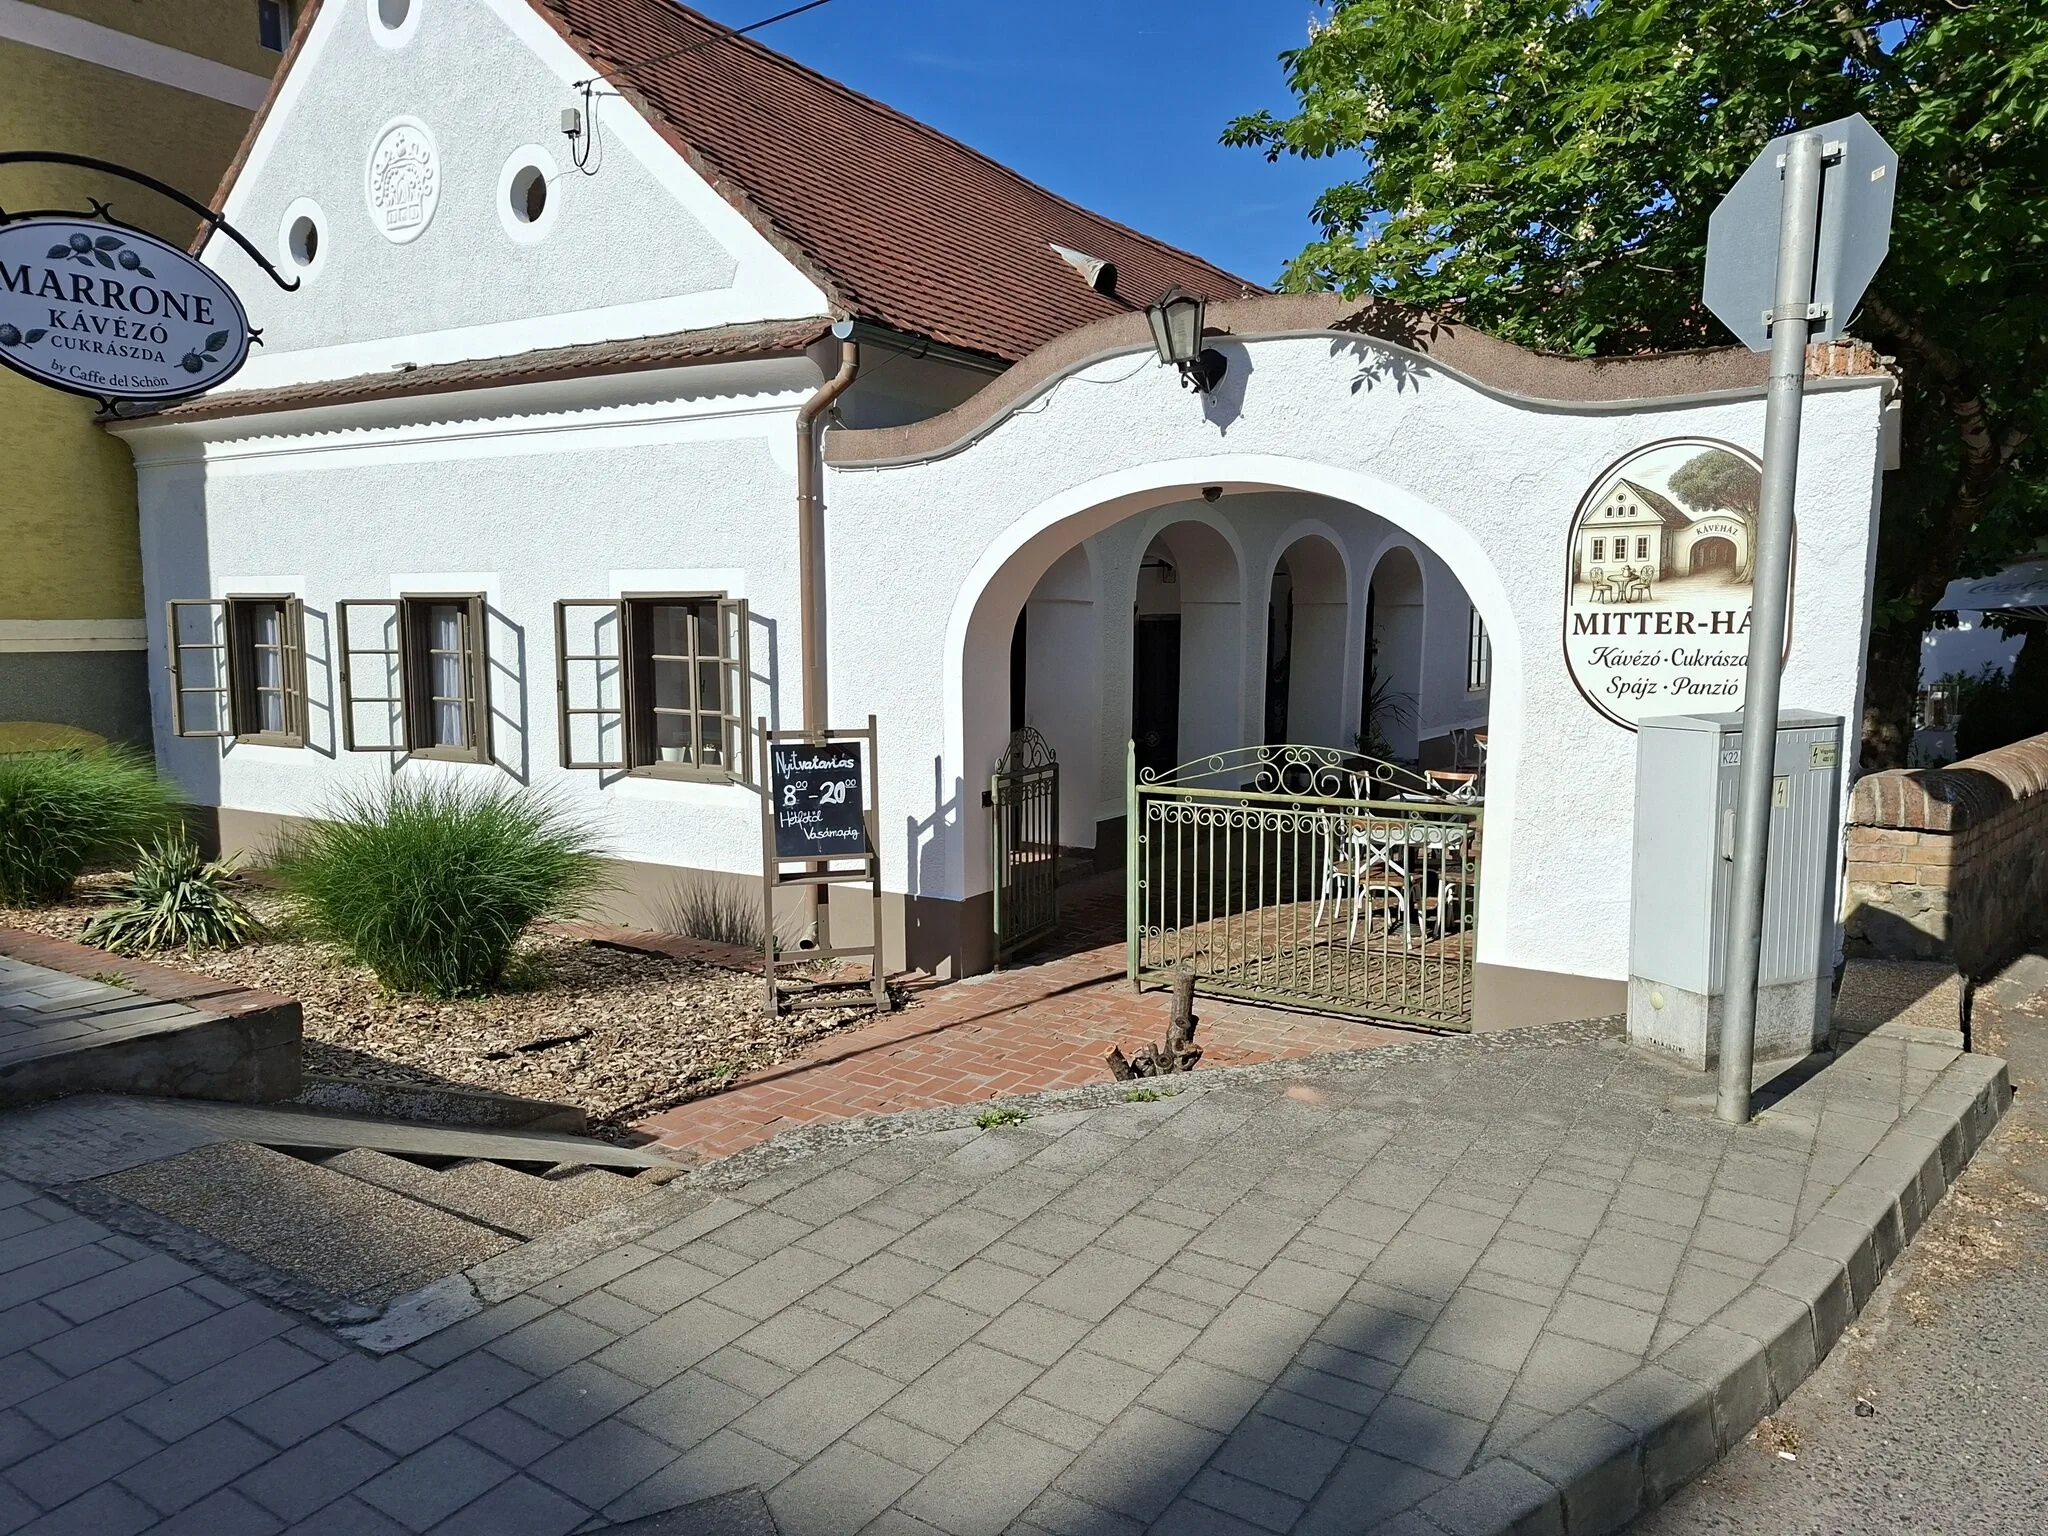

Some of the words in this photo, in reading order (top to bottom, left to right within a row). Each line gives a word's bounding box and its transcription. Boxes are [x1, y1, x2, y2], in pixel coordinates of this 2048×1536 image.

[0, 261, 215, 326] MARRONE
[48, 308, 168, 344] KÁVÉZÓ
[51, 335, 166, 363] CUKRÁSZDA
[50, 358, 67, 375] by
[69, 364, 106, 385] Caffe
[109, 374, 129, 387] del
[131, 375, 169, 388] Schön
[1695, 522, 1739, 536] KÁVÉHÁZ
[1572, 605, 1752, 636] MITTER-HÁ
[1587, 646, 1662, 669] Kávézó
[1671, 647, 1748, 667] Cukrász
[1606, 675, 1658, 700] Spájz
[1670, 676, 1739, 696] Panzió
[1722, 751, 1739, 764] K22
